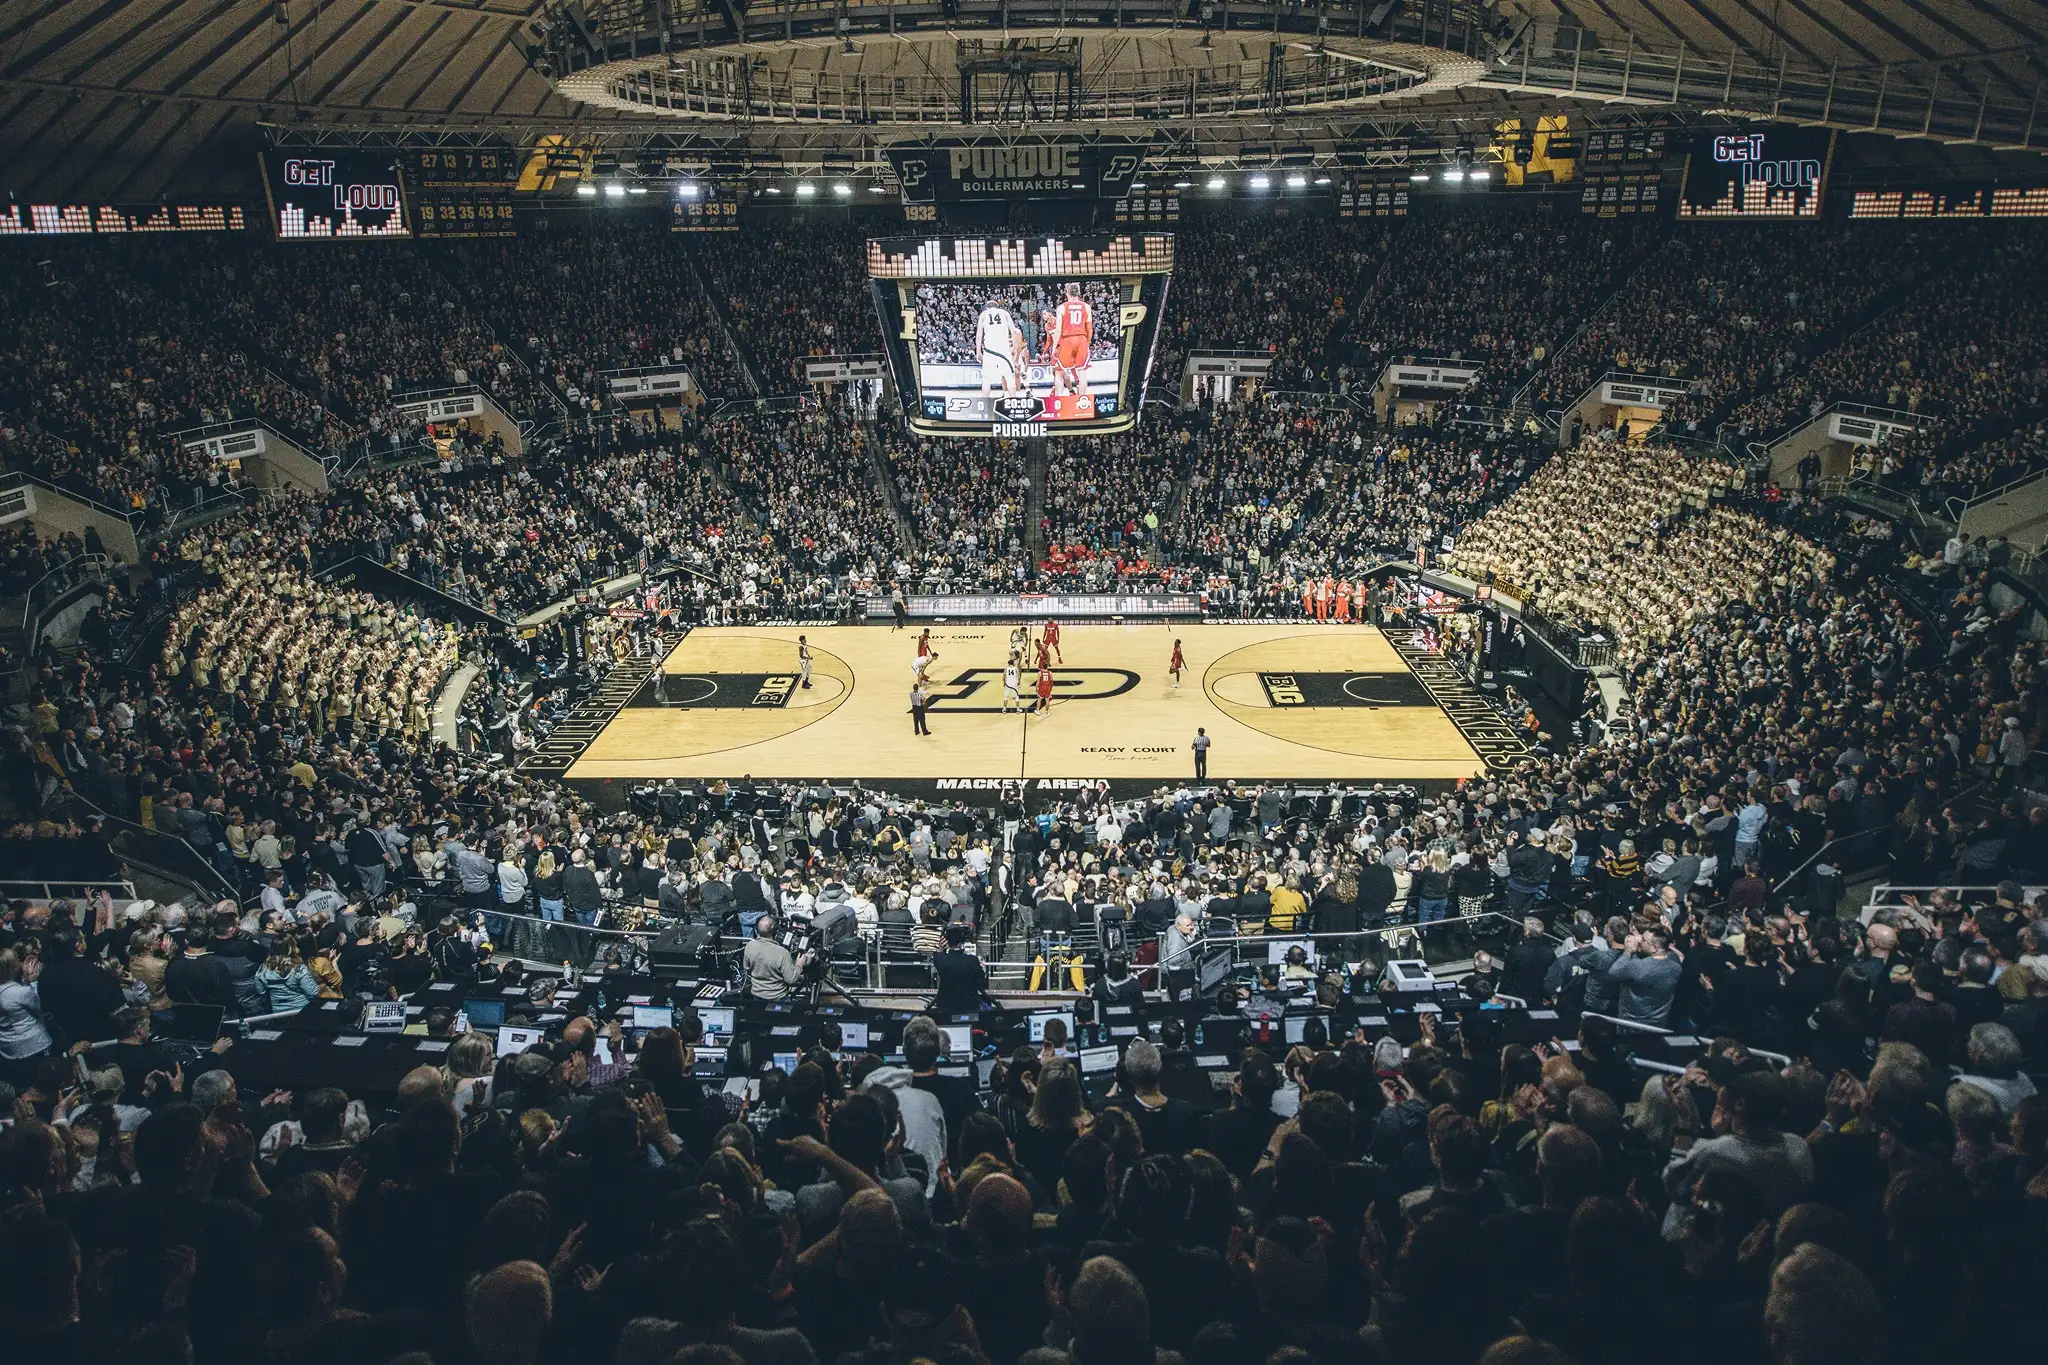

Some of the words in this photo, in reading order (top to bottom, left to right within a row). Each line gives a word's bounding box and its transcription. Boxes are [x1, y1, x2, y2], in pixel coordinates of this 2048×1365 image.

[1714, 133, 1765, 162] GET
[421, 154, 437, 168] 27
[443, 154, 456, 168] 13
[465, 154, 473, 168] 7
[480, 155, 496, 168] 23
[949, 142, 1080, 179] PURDUE
[284, 159, 335, 186] GET
[963, 180, 1069, 192] BOILERMAKERS
[334, 184, 398, 210] LOUD
[420, 206, 434, 220] 19
[440, 206, 456, 220] 32
[459, 206, 475, 220] 35
[478, 206, 495, 219] 43
[497, 205, 514, 218] 42
[674, 204, 682, 215] 4
[688, 204, 703, 216] 25
[705, 203, 720, 215] 33
[723, 203, 737, 215] 50
[904, 206, 936, 221] 1932
[988, 314, 1002, 325] 14
[1069, 310, 1082, 324] 10
[977, 401, 984, 410] 0
[1004, 398, 1034, 410] 20:00
[1054, 400, 1062, 410] 0
[992, 423, 1047, 437] PURDUE
[936, 779, 1029, 789] MACKEY
[1037, 779, 1110, 789] ARENA
[307, 894, 332, 906] LANDMARK
